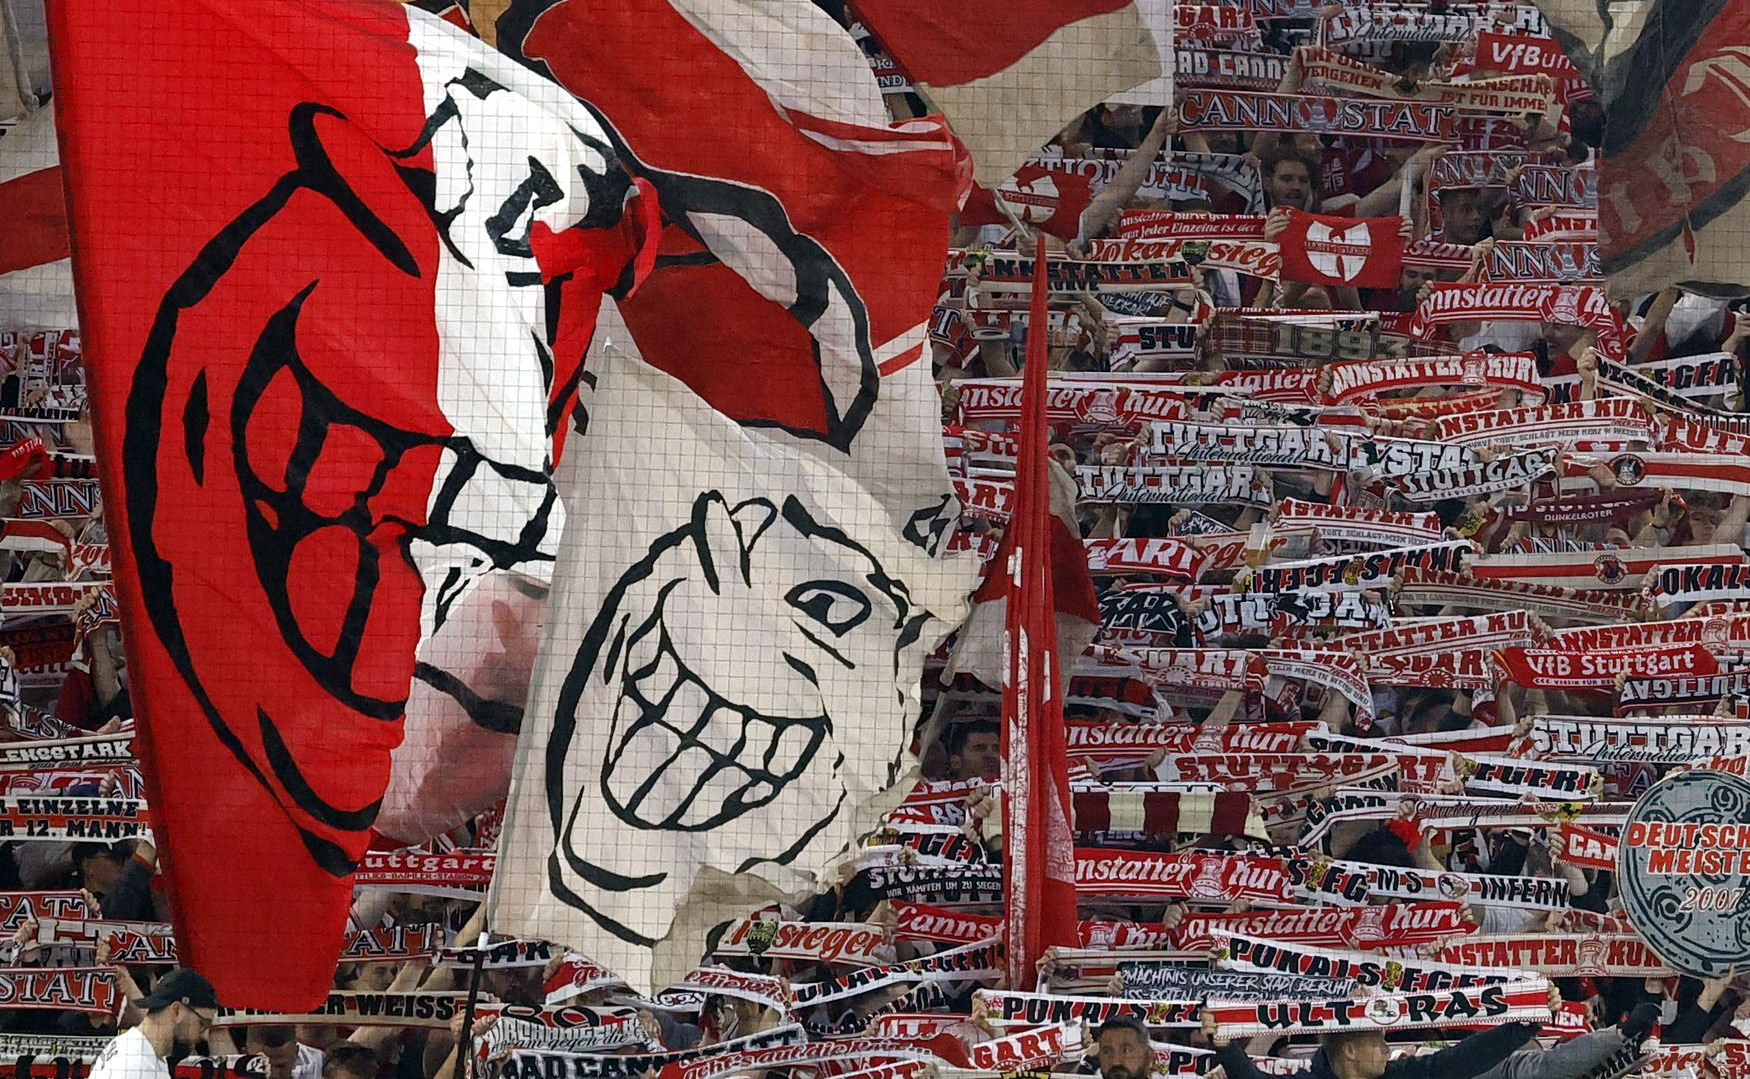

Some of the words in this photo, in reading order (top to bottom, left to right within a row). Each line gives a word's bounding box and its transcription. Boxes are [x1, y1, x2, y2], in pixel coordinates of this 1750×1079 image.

[1220, 53, 1291, 80] CANNS
[1491, 40, 1582, 71] VfBun
[1178, 92, 1292, 127] CANN
[1420, 285, 1554, 318] annstatter
[1333, 354, 1462, 388] ANNSTATTER
[1595, 398, 1645, 420] KUR
[1147, 425, 1338, 462] TUTTGAR
[1077, 469, 1258, 497] TUTTGAR
[1400, 567, 1575, 599] ANNSTATTER
[1548, 621, 1701, 649] ANNSTATTER
[1525, 654, 1573, 676] VfB
[1580, 651, 1696, 680] Stuttgart
[1066, 723, 1197, 748] nnstatter
[1531, 722, 1750, 755] STUTTGAR
[18, 799, 140, 818] EINZELNE
[67, 819, 150, 839] MANN!
[359, 854, 497, 871] uttgart
[1480, 876, 1571, 910] INFERN
[1680, 885, 1747, 912] 2007
[1439, 939, 1578, 968] NSTATTER
[1606, 940, 1662, 967] KUR
[356, 995, 455, 1019] WEISS
